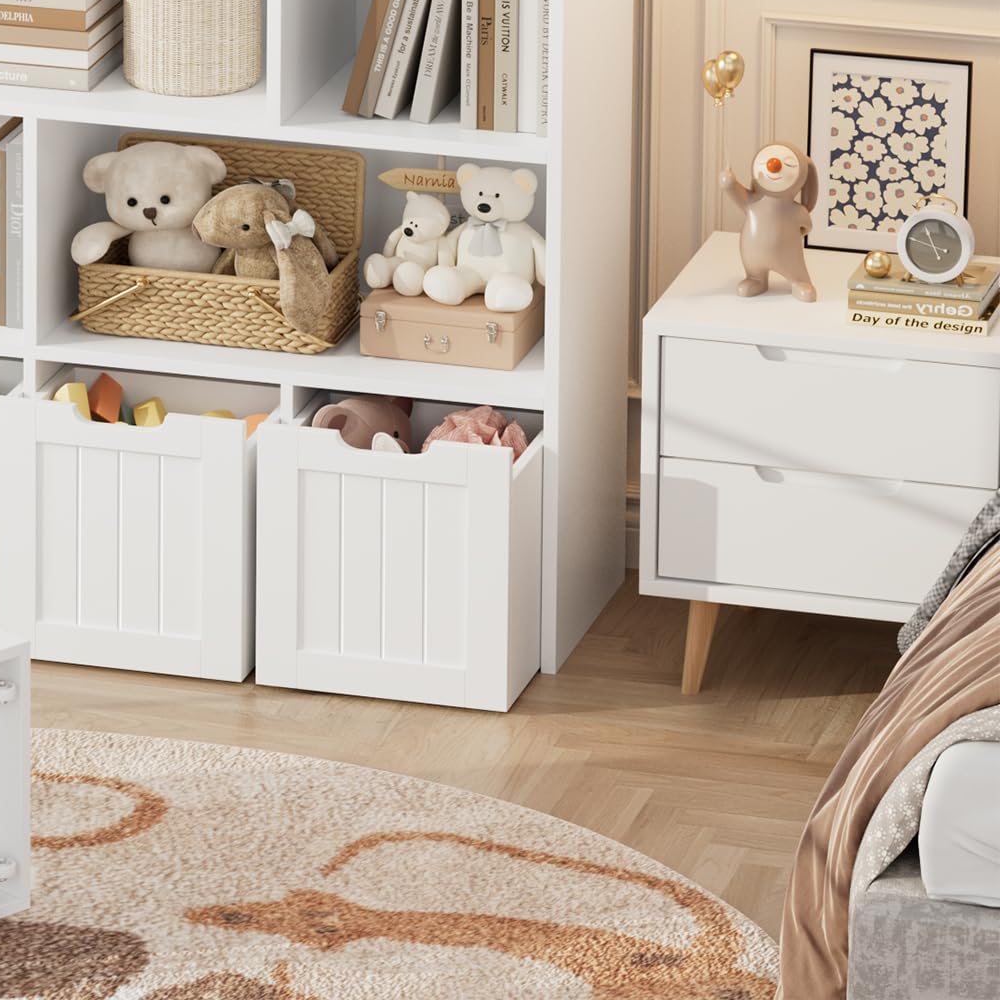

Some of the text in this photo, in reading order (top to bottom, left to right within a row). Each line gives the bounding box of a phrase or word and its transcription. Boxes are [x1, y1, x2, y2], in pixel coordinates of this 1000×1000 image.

[466, 1, 474, 13] Be
[373, 54, 387, 73] THIS
[384, 9, 399, 35] GOOD
[466, 22, 474, 59] Machine
[481, 16, 492, 46] Paris
[501, 12, 511, 53] VUITTON
[397, 41, 408, 55] for
[403, 173, 455, 188] Narnia
[10, 202, 24, 238] Dior
[852, 313, 983, 334] Day of the design
